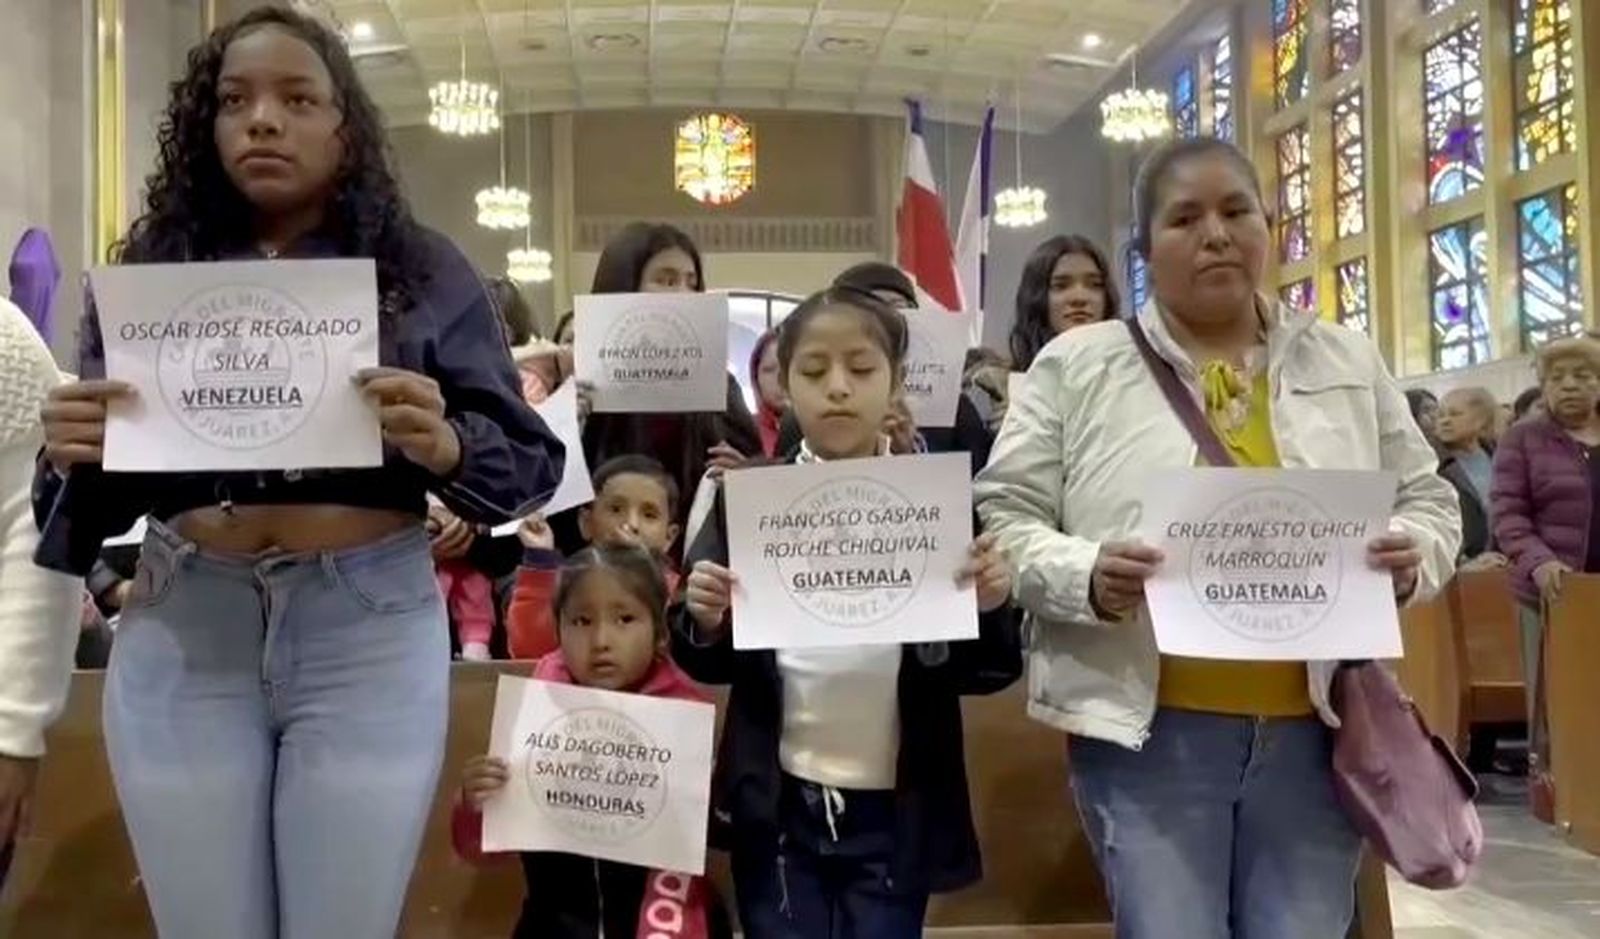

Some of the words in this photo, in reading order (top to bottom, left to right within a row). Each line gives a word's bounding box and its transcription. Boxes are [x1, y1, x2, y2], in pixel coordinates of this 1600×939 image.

[120, 321, 190, 341] OSCAR
[250, 319, 362, 338] REGALADO
[213, 353, 271, 372] SILVA
[181, 386, 303, 407] VENEZUELA
[759, 508, 862, 532] FRANCISCO
[867, 506, 941, 526] GASPAR
[1167, 522, 1218, 538] CRUZ
[1222, 522, 1305, 538] ERNESTO
[1310, 521, 1367, 538] CHICH
[764, 540, 834, 559] ROJCHE
[839, 536, 939, 557] CHIQUIVAL
[792, 567, 913, 590] GUATEMALA
[1205, 583, 1328, 602] GUATEMALA
[525, 732, 560, 750] ALIS
[564, 737, 672, 764] DAGOBERTO
[535, 760, 600, 783] SANTOS
[546, 788, 646, 816] HONDURAS
